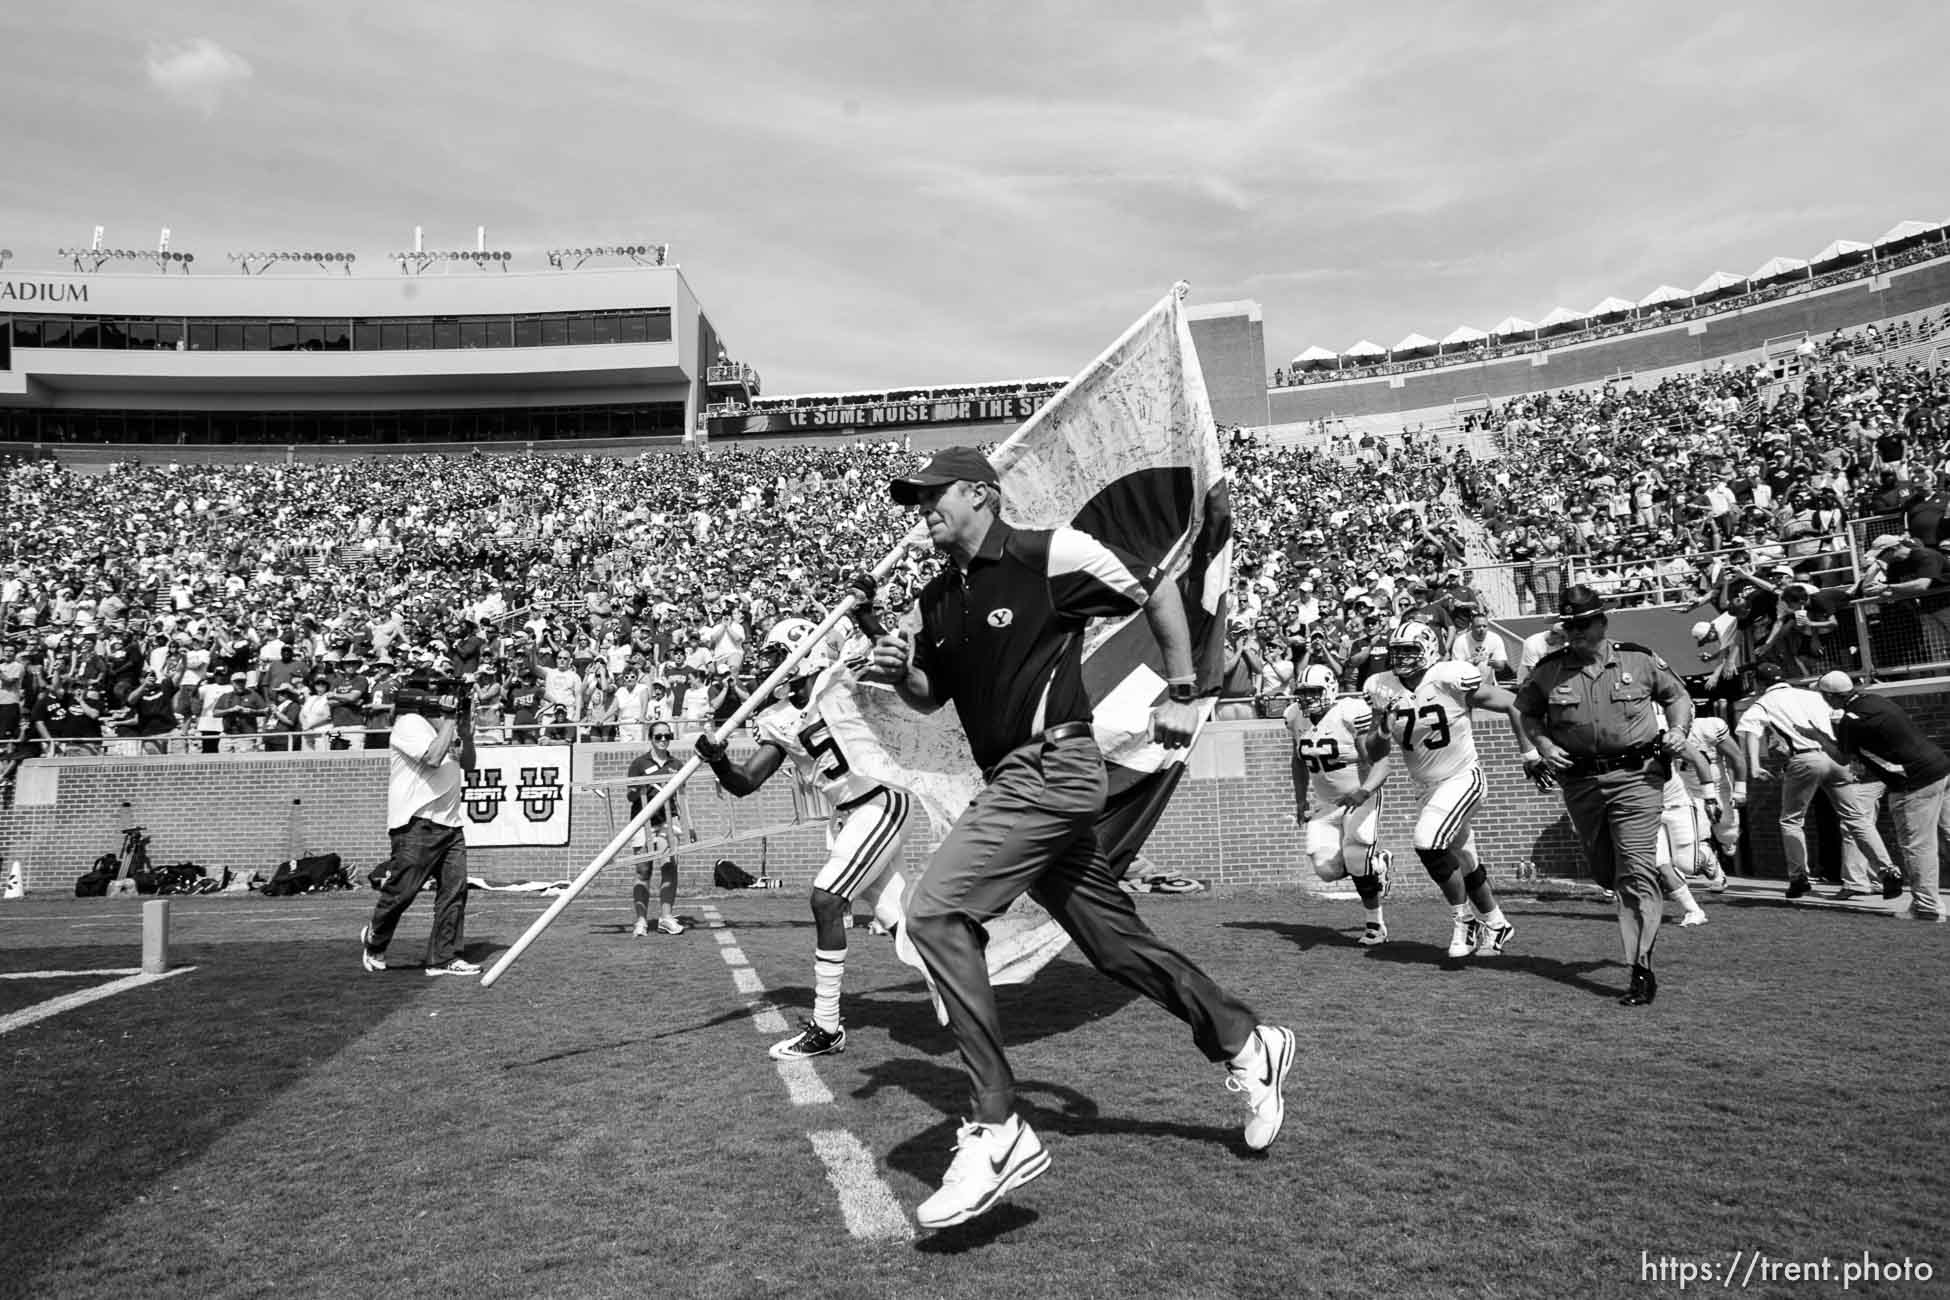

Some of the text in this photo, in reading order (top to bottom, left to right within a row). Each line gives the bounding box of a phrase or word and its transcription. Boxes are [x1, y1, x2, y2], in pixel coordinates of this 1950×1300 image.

[0, 281, 89, 302] ADIUM
[814, 409, 865, 425] SOME
[872, 404, 929, 423] NOISE
[931, 402, 970, 421] OR
[979, 399, 1013, 417] THE
[991, 609, 1009, 625] Y
[653, 704, 662, 721] 5
[1395, 703, 1451, 752] 73
[798, 717, 850, 781] 5
[1299, 738, 1347, 774] 62
[464, 787, 503, 801] ESPN
[520, 785, 559, 800] ESPN
